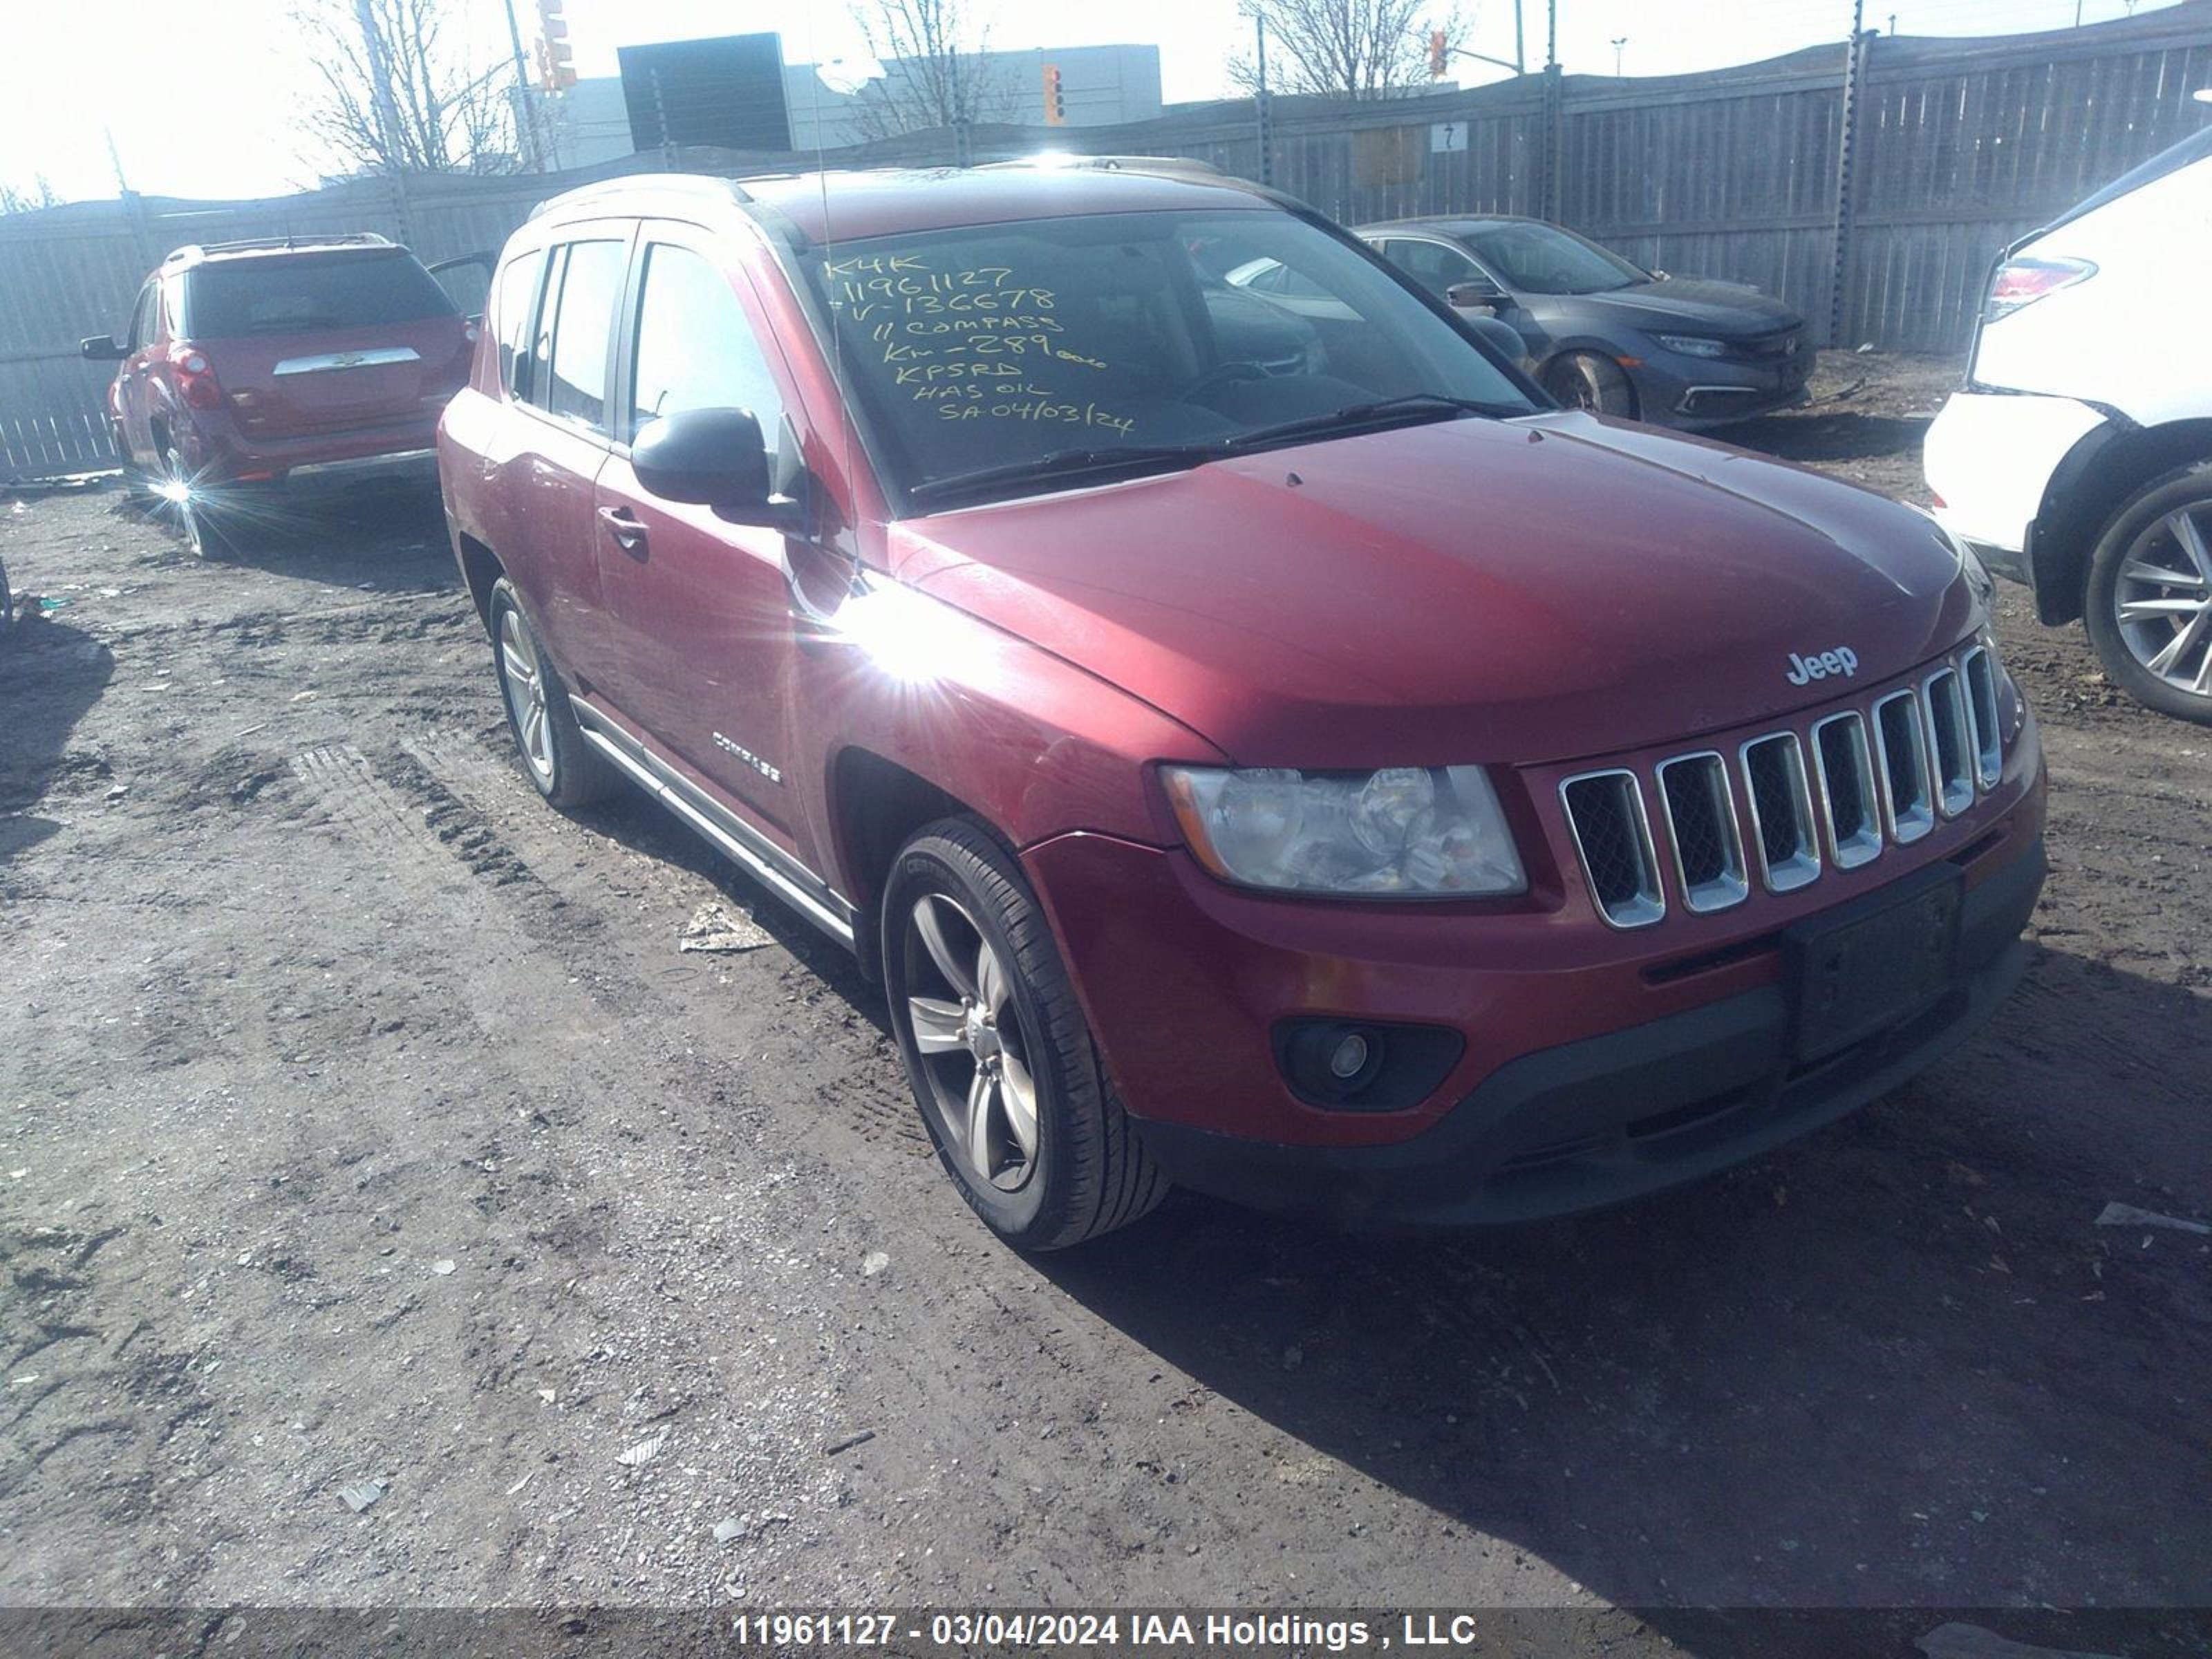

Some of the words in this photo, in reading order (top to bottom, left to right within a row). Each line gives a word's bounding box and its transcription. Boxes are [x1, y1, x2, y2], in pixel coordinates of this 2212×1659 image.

[843, 268, 1013, 304] 11961127
[912, 384, 984, 401] HAS
[995, 382, 1053, 395] OIL
[1787, 646, 1859, 685] Jeep
